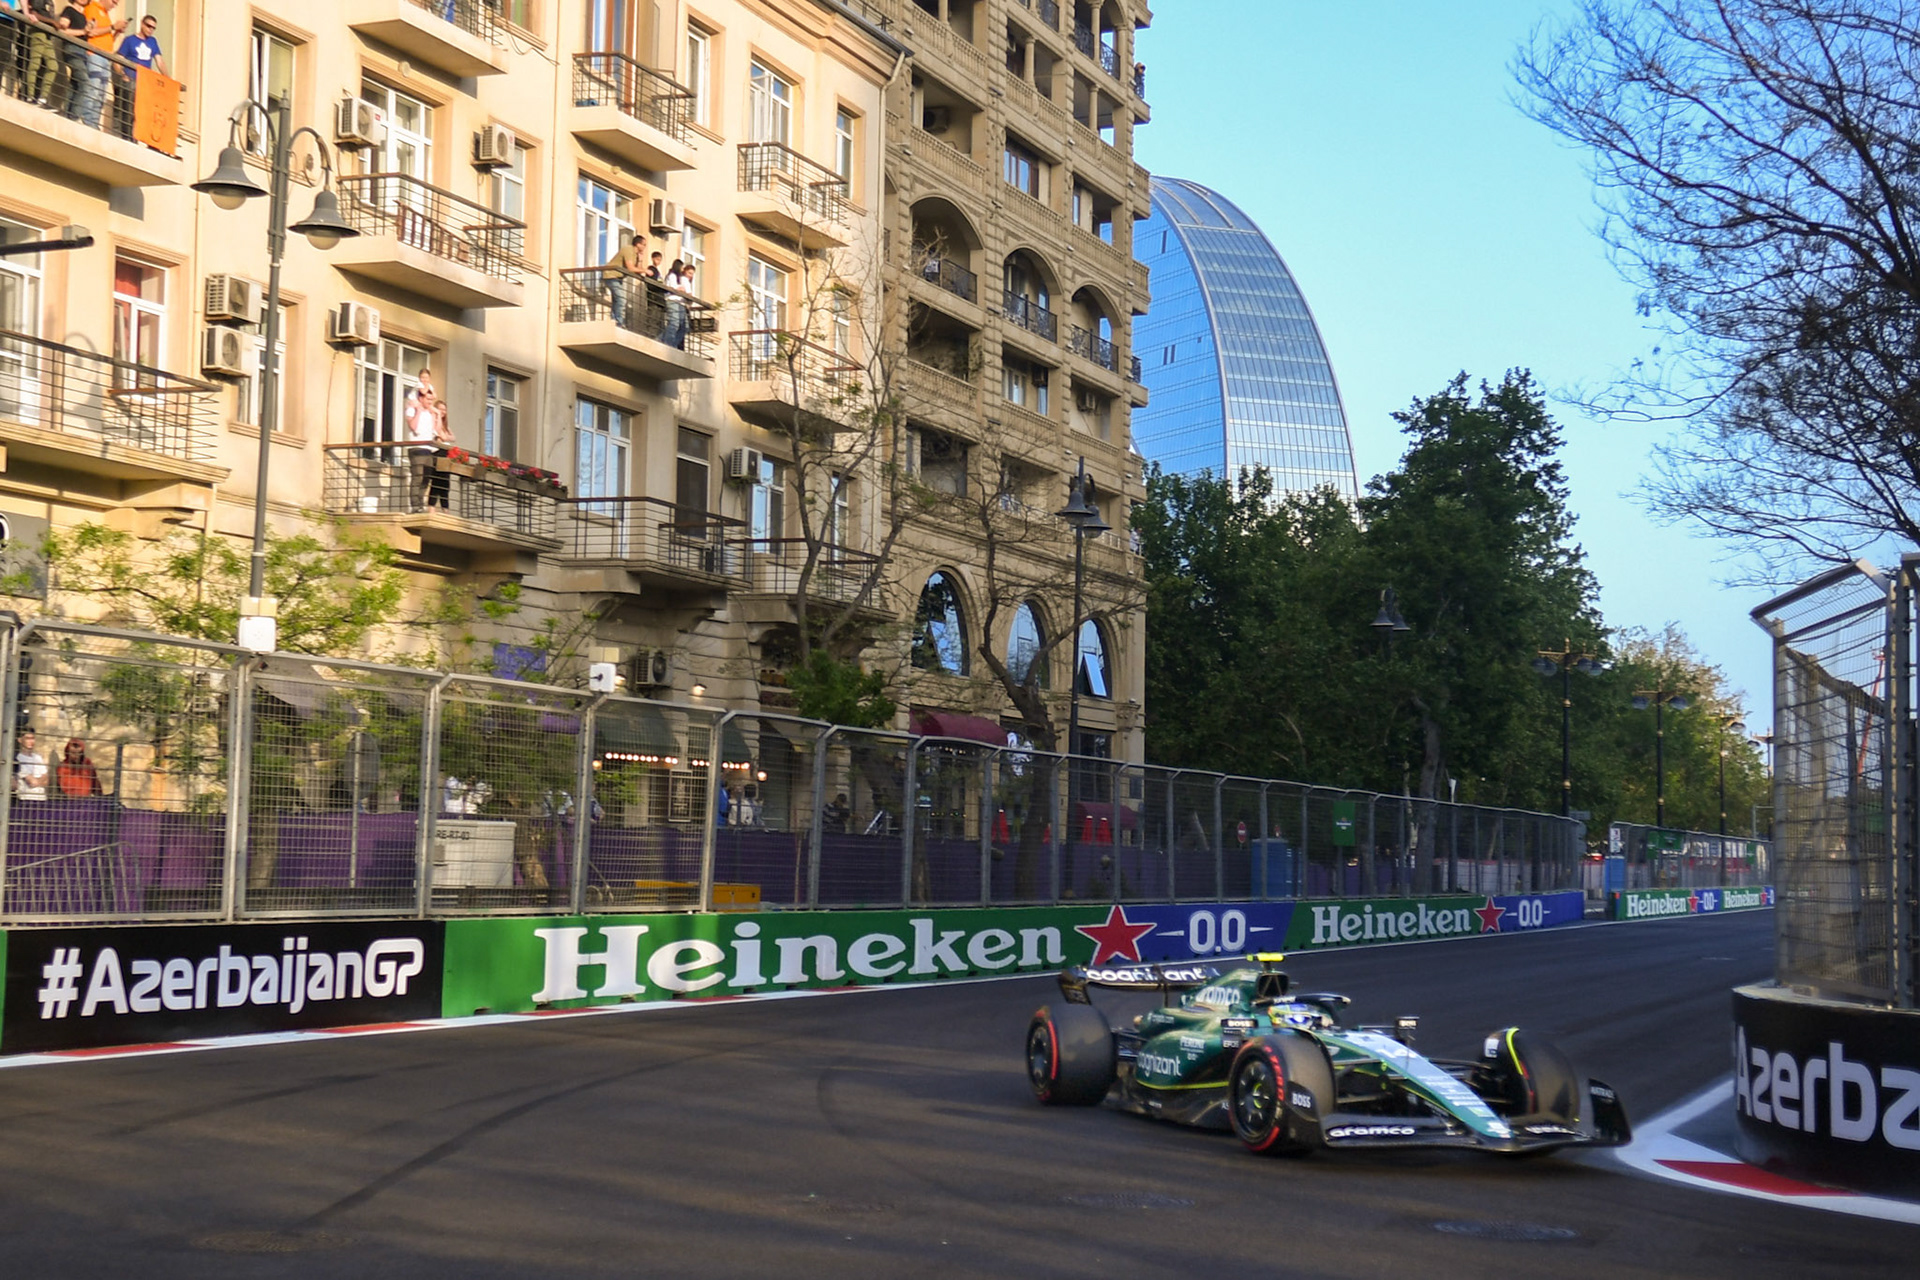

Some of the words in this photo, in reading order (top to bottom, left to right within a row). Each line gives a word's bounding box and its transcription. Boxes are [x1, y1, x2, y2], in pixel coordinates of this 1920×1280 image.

[1517, 899, 1543, 927] 0.0
[1626, 893, 1687, 918] Heineken
[1723, 889, 1760, 909] Heineken
[1188, 909, 1247, 954] 0.0
[1310, 903, 1471, 945] Heineken
[531, 919, 1067, 1003] Heineken
[1086, 967, 1206, 982] cogniant
[38, 936, 425, 1020] #AzerbaijanGP
[1292, 1092, 1311, 1108] BOSS
[1737, 1025, 1920, 1151] Azerba
[1329, 1125, 1416, 1138] aramco
